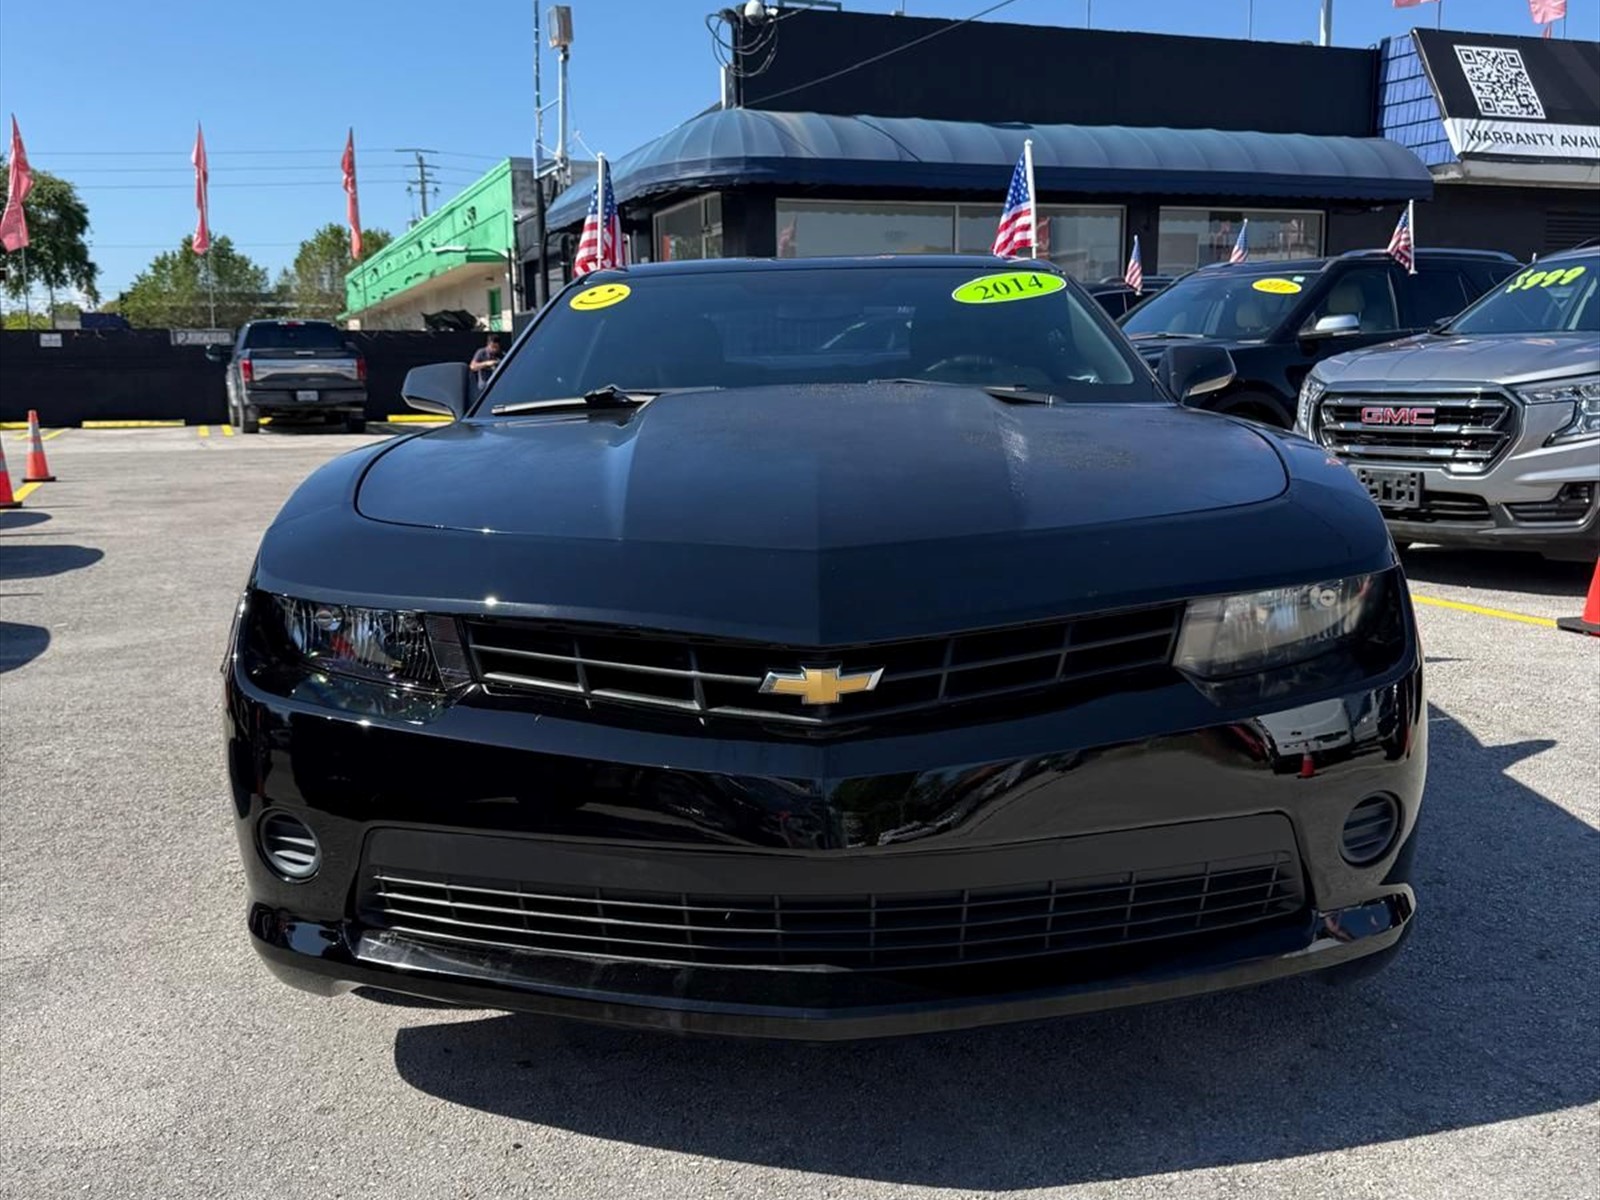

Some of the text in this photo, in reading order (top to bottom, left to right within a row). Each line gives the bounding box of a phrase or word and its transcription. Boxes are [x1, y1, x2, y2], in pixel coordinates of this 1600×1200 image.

[1466, 128, 1600, 149] WARRANTY AVAIL
[974, 274, 1044, 301] 2014
[1505, 265, 1587, 294] $999
[1361, 406, 1436, 425] GMC
